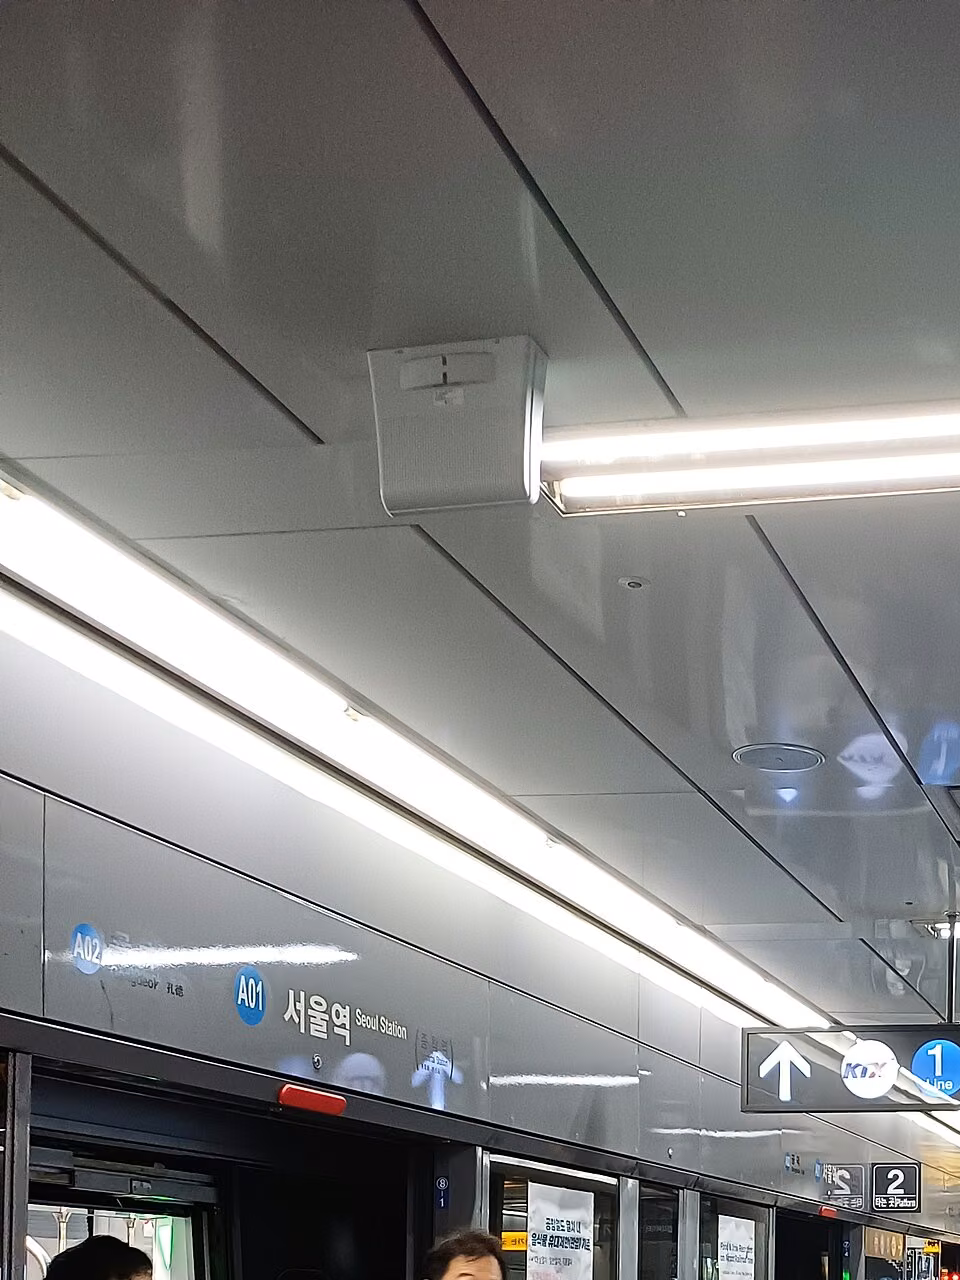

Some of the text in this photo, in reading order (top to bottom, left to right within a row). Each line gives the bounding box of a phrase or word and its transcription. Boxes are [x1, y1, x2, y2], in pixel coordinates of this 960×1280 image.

[73, 932, 101, 964] A02
[237, 975, 264, 1011] A01
[283, 988, 407, 1046] 서울역 Seoul Station
[928, 1043, 943, 1077] 1
[886, 1168, 905, 1195] 2
